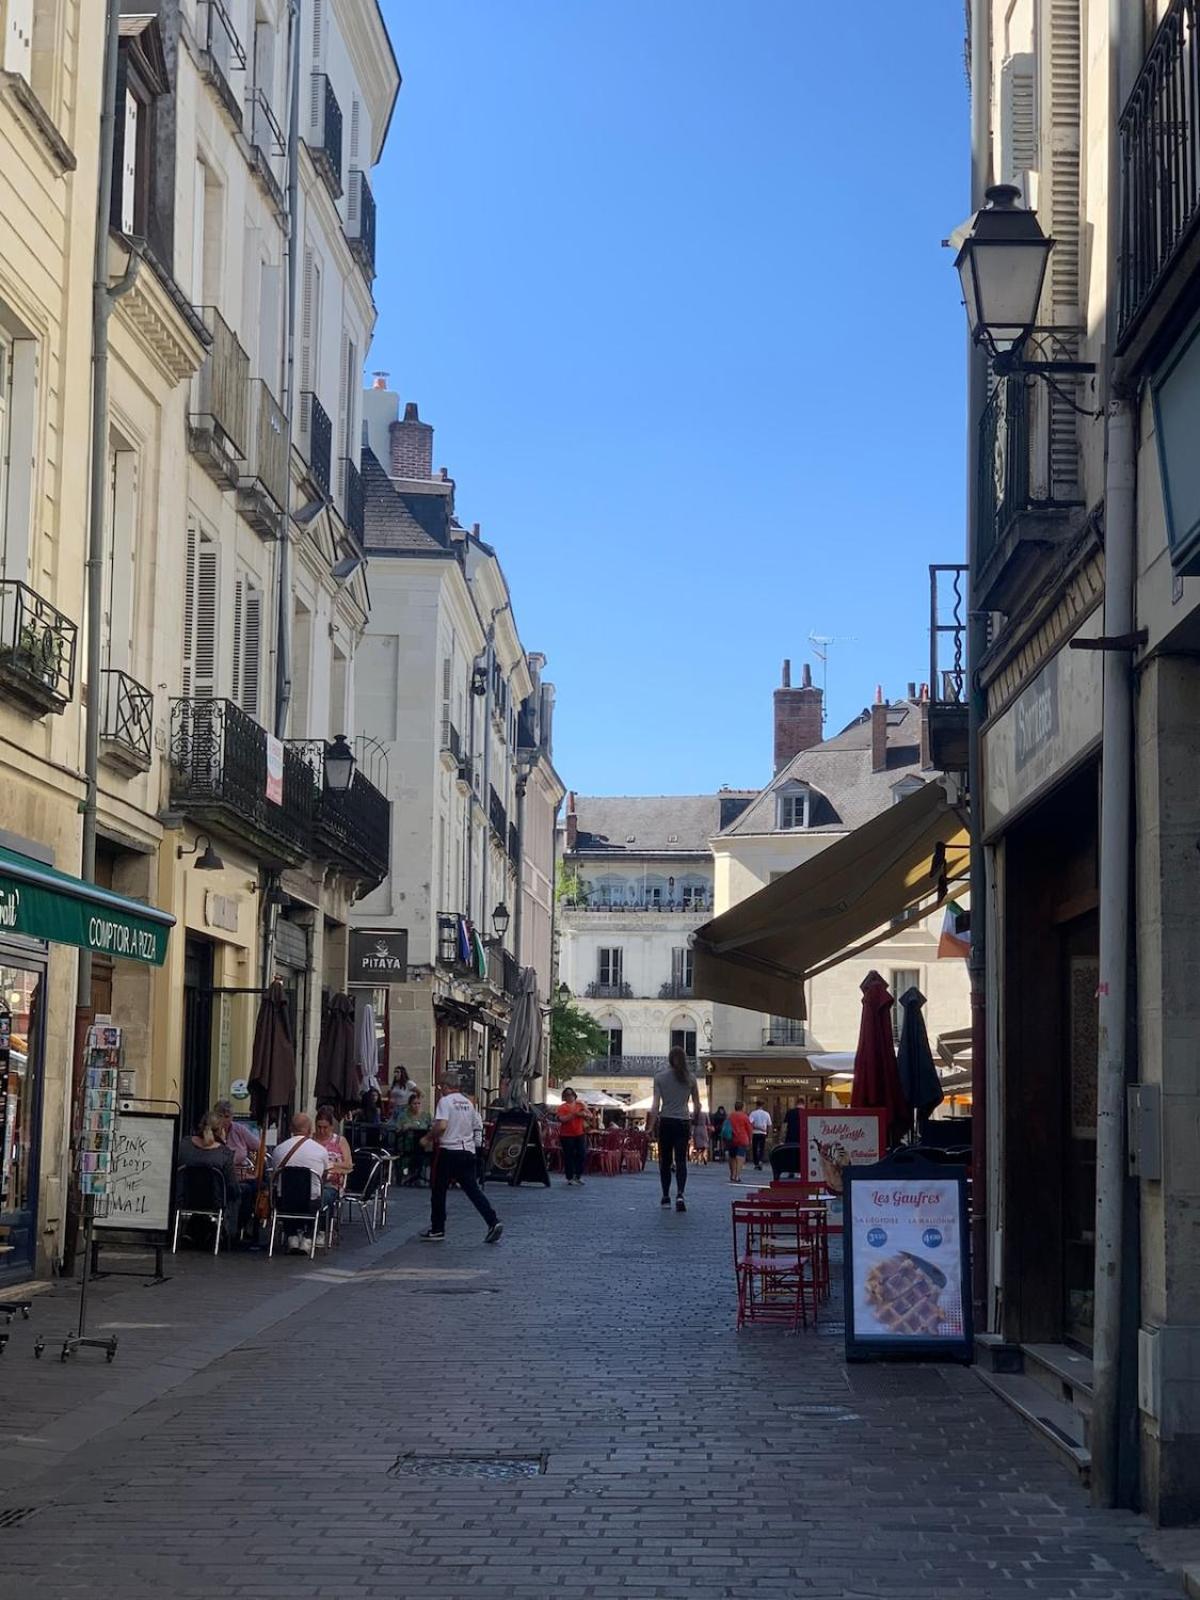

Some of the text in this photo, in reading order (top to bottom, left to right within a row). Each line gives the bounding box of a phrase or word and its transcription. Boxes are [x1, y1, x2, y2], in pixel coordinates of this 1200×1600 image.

[362, 958, 401, 969] PITAYA
[115, 1135, 148, 1154] PINK
[115, 1151, 152, 1173] FLOYD
[872, 1191, 941, 1208] Les Gaufres
